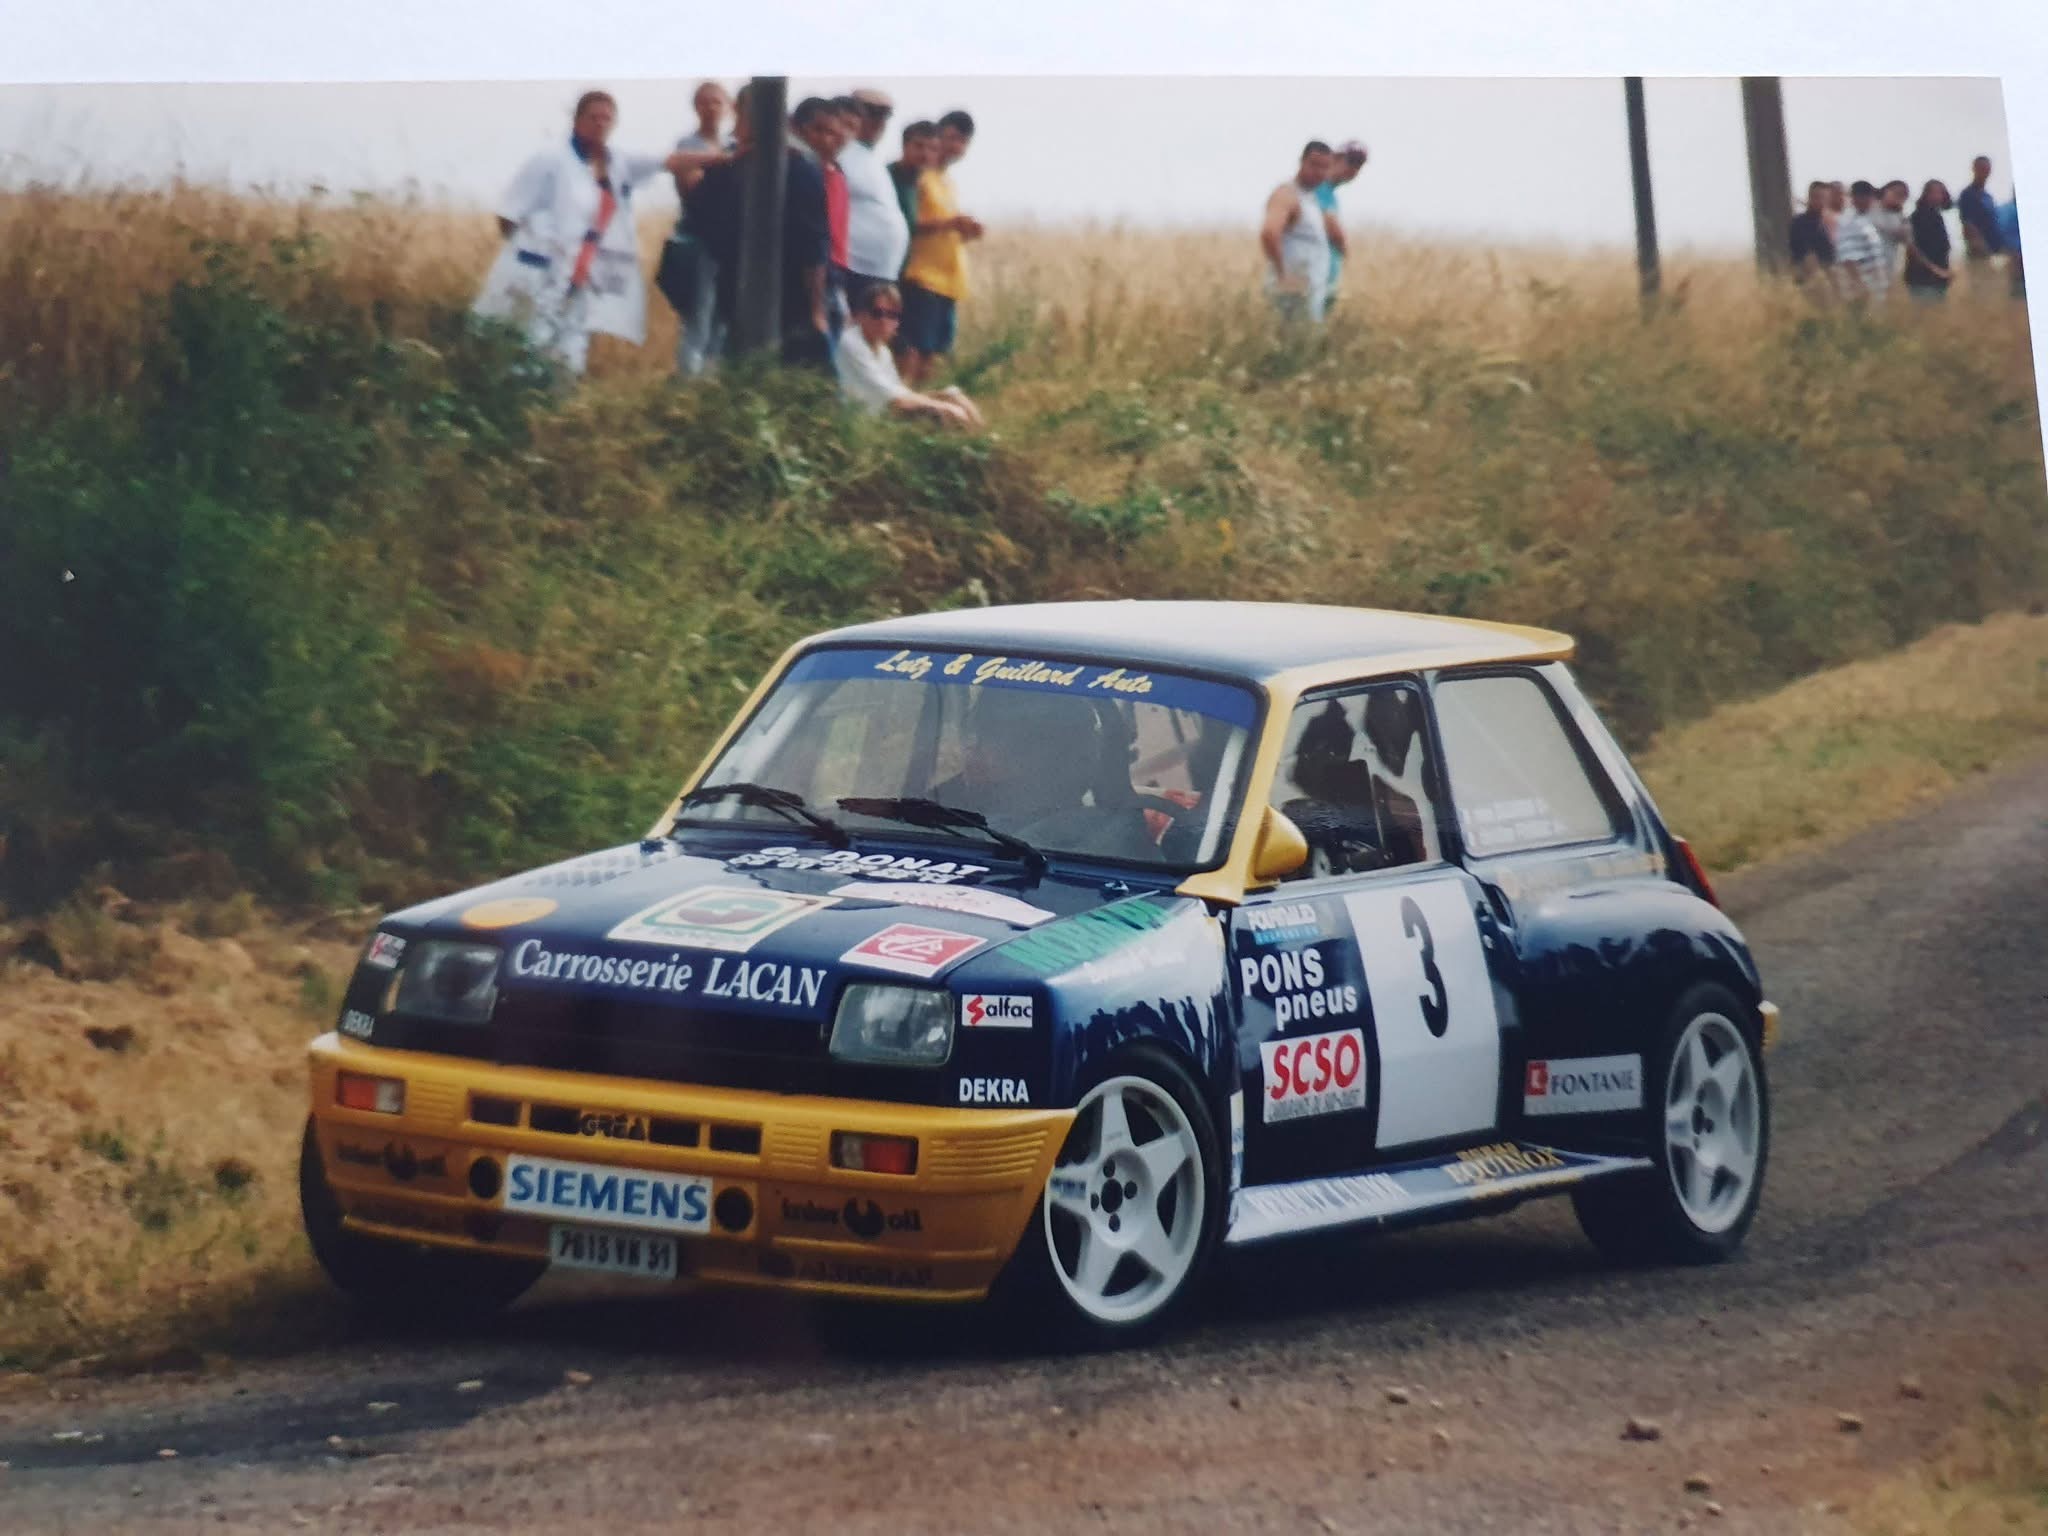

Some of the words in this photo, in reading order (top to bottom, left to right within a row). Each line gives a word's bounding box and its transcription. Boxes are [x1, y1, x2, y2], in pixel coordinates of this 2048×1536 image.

[943, 653, 973, 675] &
[1088, 668, 1152, 693] Auto
[821, 850, 990, 875] DONAT
[513, 937, 693, 992] Carrosserie
[704, 956, 828, 1008] LACAN
[1240, 948, 1325, 997] PONS
[1401, 895, 1449, 1038] 3
[1275, 985, 1358, 1031] pneus
[959, 1077, 1029, 1103] DEKRA
[1271, 1034, 1361, 1100] SCSO
[509, 1163, 709, 1222] SIEMENS
